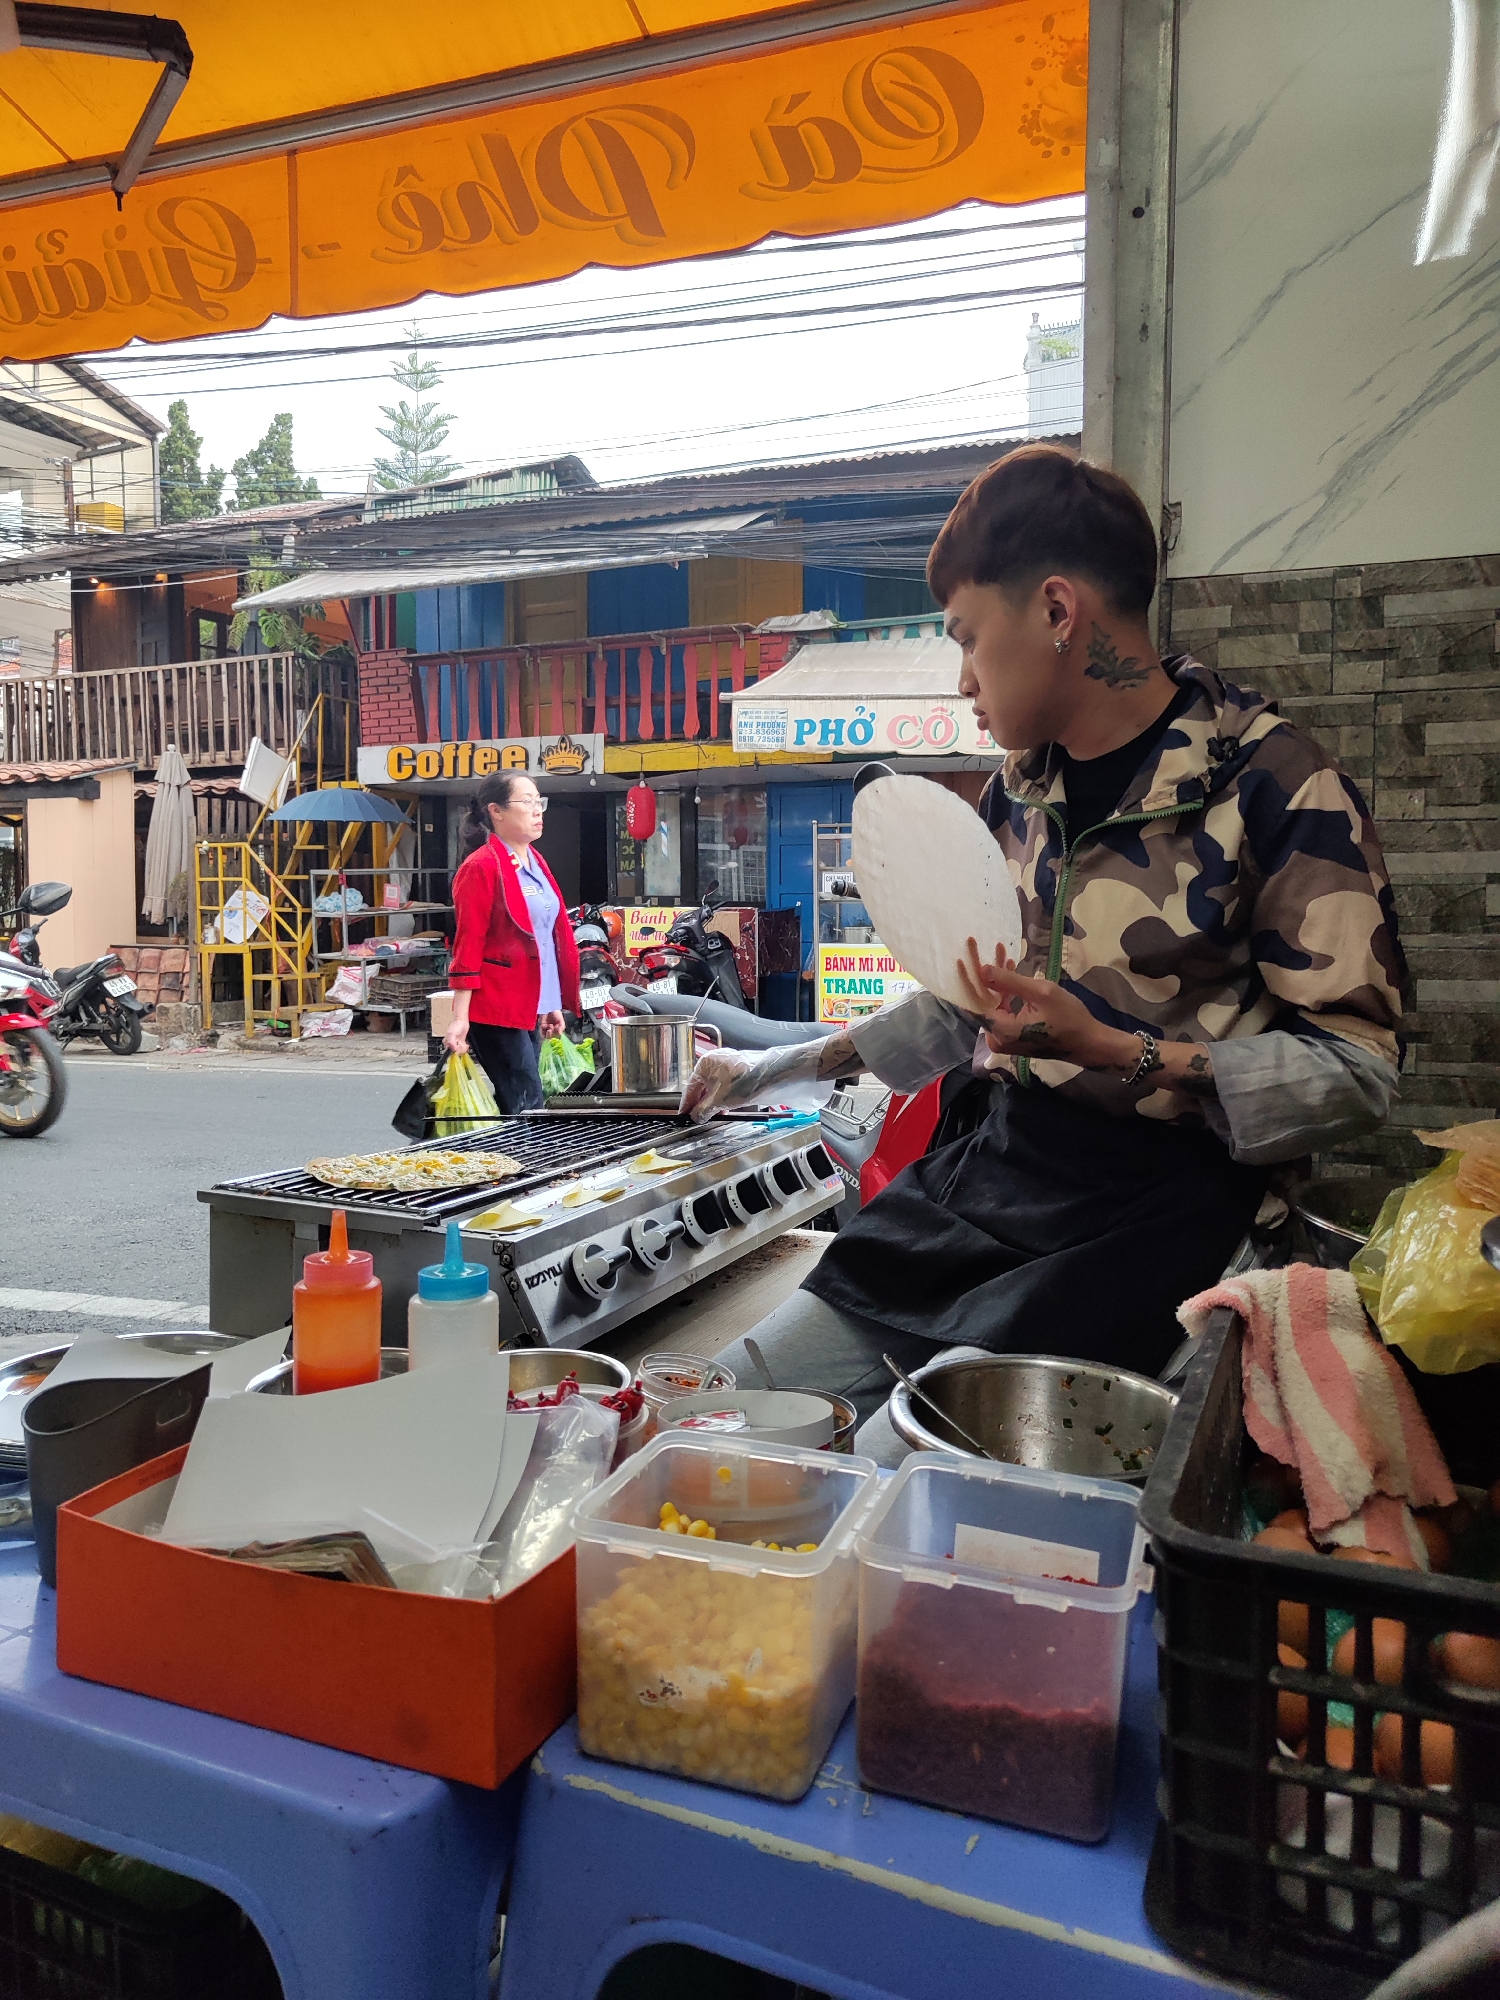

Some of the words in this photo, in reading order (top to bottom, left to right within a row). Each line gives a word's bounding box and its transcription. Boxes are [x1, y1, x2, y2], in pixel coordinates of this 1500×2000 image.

[738, 721, 754, 729] ANH
[793, 705, 876, 746] PHỞ
[887, 705, 959, 749] CÔ
[387, 741, 529, 781] Coffee
[630, 910, 668, 925] Bánh
[825, 953, 855, 972] BÁNH
[859, 953, 874, 972] MÌ
[876, 954, 896, 972] XÍU
[823, 978, 884, 995] TRANG
